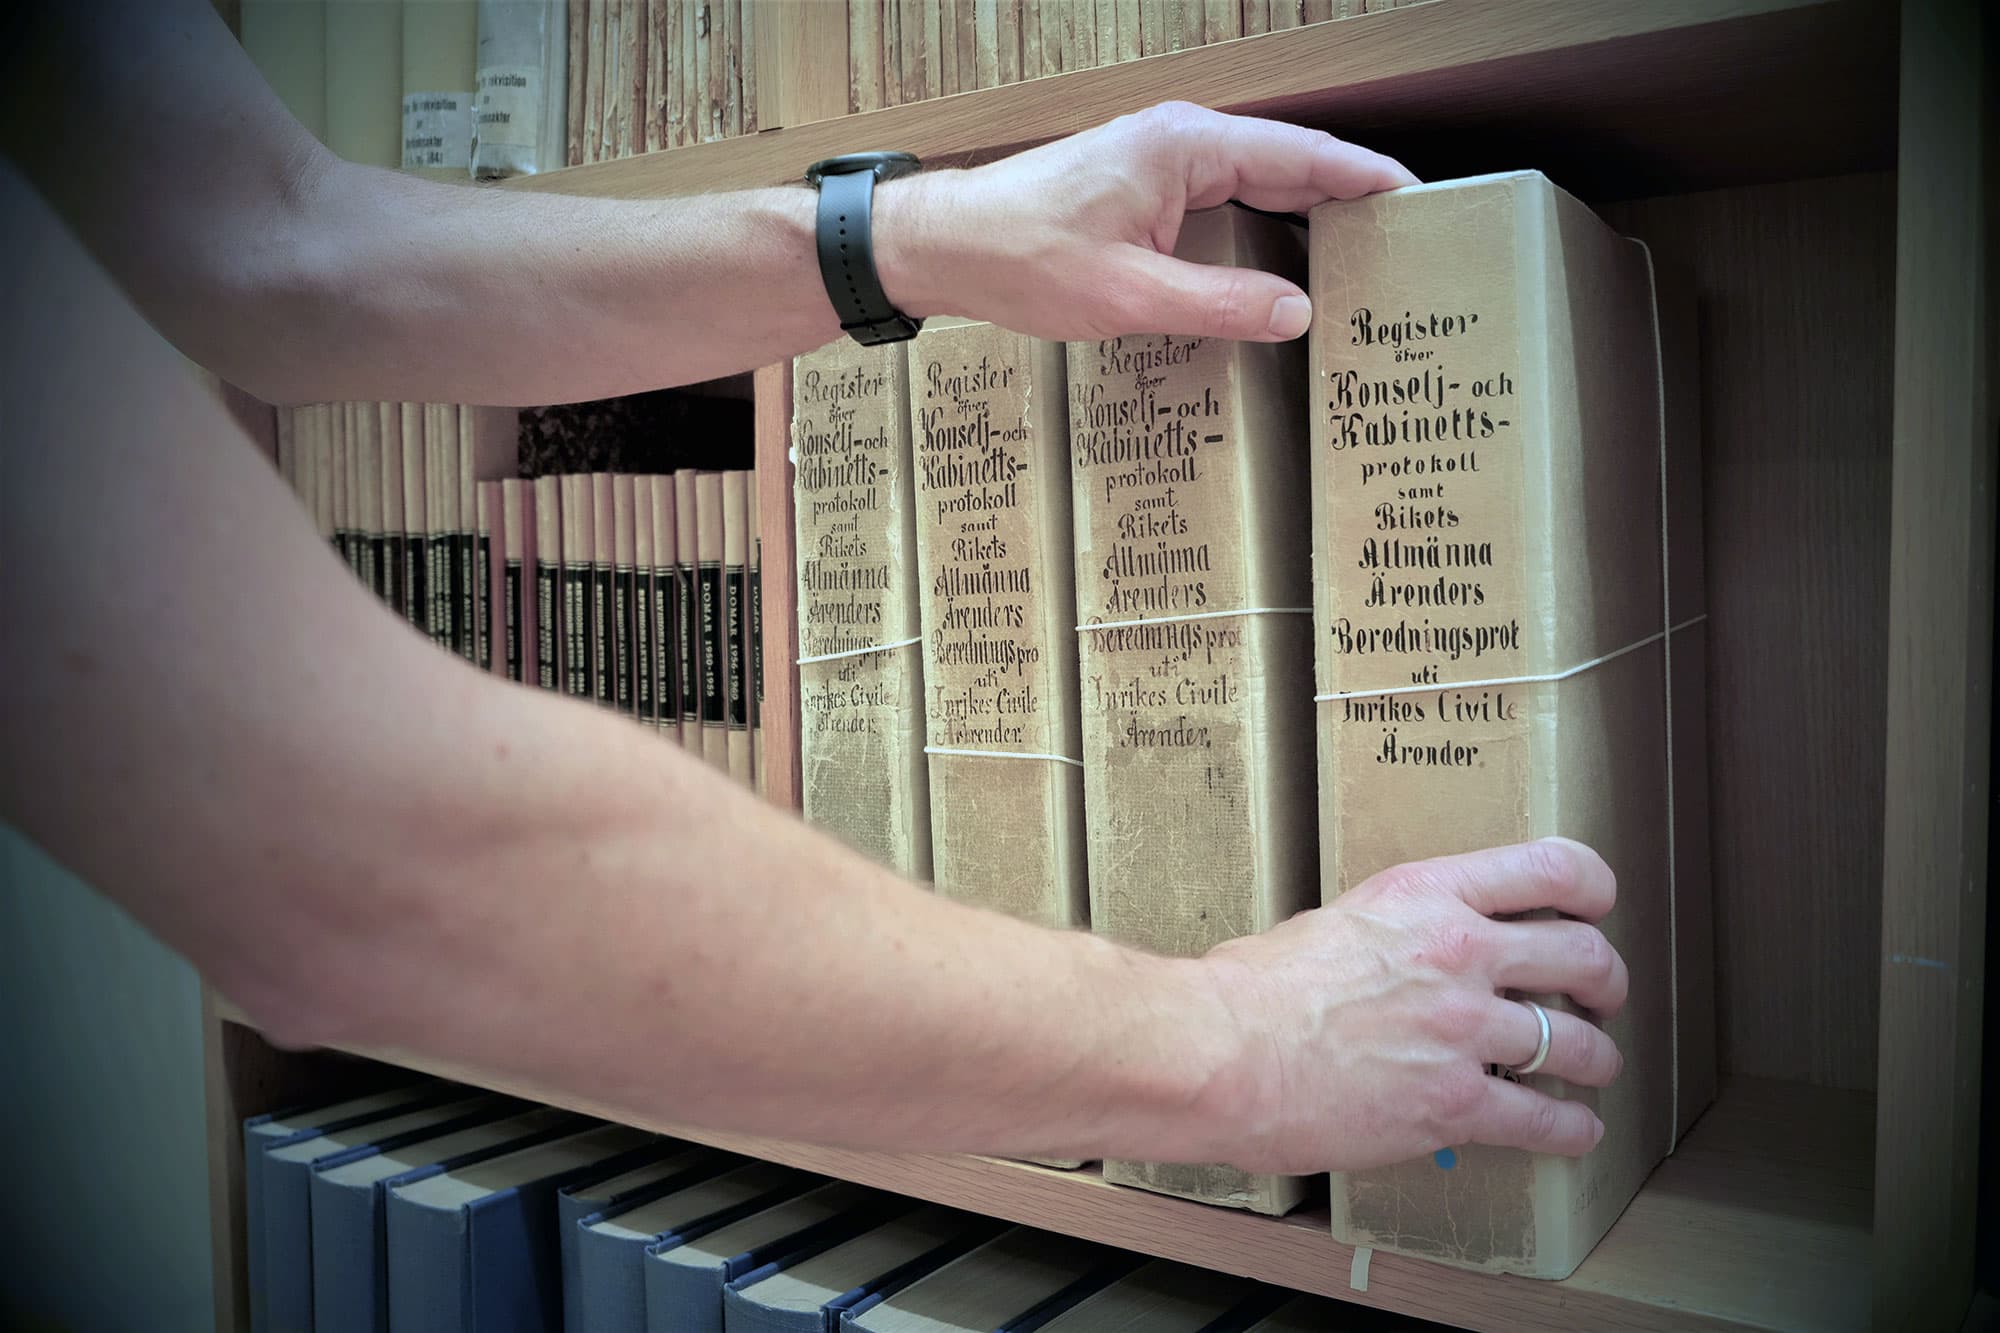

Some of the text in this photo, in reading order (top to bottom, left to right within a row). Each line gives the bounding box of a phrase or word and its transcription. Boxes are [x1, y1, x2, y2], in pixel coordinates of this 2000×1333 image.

[1351, 307, 1478, 348] Register
[1100, 336, 1202, 377] Register
[1395, 347, 1434, 363] öfver
[804, 366, 884, 406] Register
[927, 356, 1014, 402] Register
[1329, 365, 1514, 410] Konselj- och
[957, 400, 988, 420] öfver
[1177, 388, 1219, 417] och
[864, 426, 888, 449] och
[918, 407, 1027, 455] Konselj- och
[1330, 408, 1510, 450] Kabinetts-
[919, 448, 1028, 492] Kabinetts-
[1106, 456, 1203, 503] protokoll
[1361, 451, 1480, 485] protokoll
[813, 487, 878, 525] protokoll
[938, 482, 1018, 525] protokoll
[1135, 487, 1178, 511] samt
[1398, 483, 1444, 500] samt
[831, 514, 860, 534] samt
[961, 514, 998, 533] samt
[1117, 509, 1188, 540] Rikets
[1375, 502, 1459, 530] Rikets
[819, 533, 867, 558] Rikets
[952, 535, 1007, 561] Rikets
[1103, 541, 1211, 579] Allmänna
[1358, 536, 1493, 569] Allmänna
[802, 561, 889, 591] Allmänna
[934, 563, 1030, 597] Allmänna
[1364, 572, 1484, 607] Ärenders
[729, 586, 738, 636] DOMAR
[807, 592, 881, 625] Ärenders
[1105, 575, 1207, 614] Ärenders
[942, 597, 1024, 631] Ärenders
[703, 583, 715, 697] DOMAR 1950-1955
[1331, 618, 1519, 660] Beredningsprot
[838, 662, 857, 682] uti
[974, 668, 999, 687] uti
[1411, 665, 1440, 685] uti
[996, 685, 1037, 714] Civile
[1175, 674, 1238, 705] Civile
[1438, 690, 1518, 722] Civile
